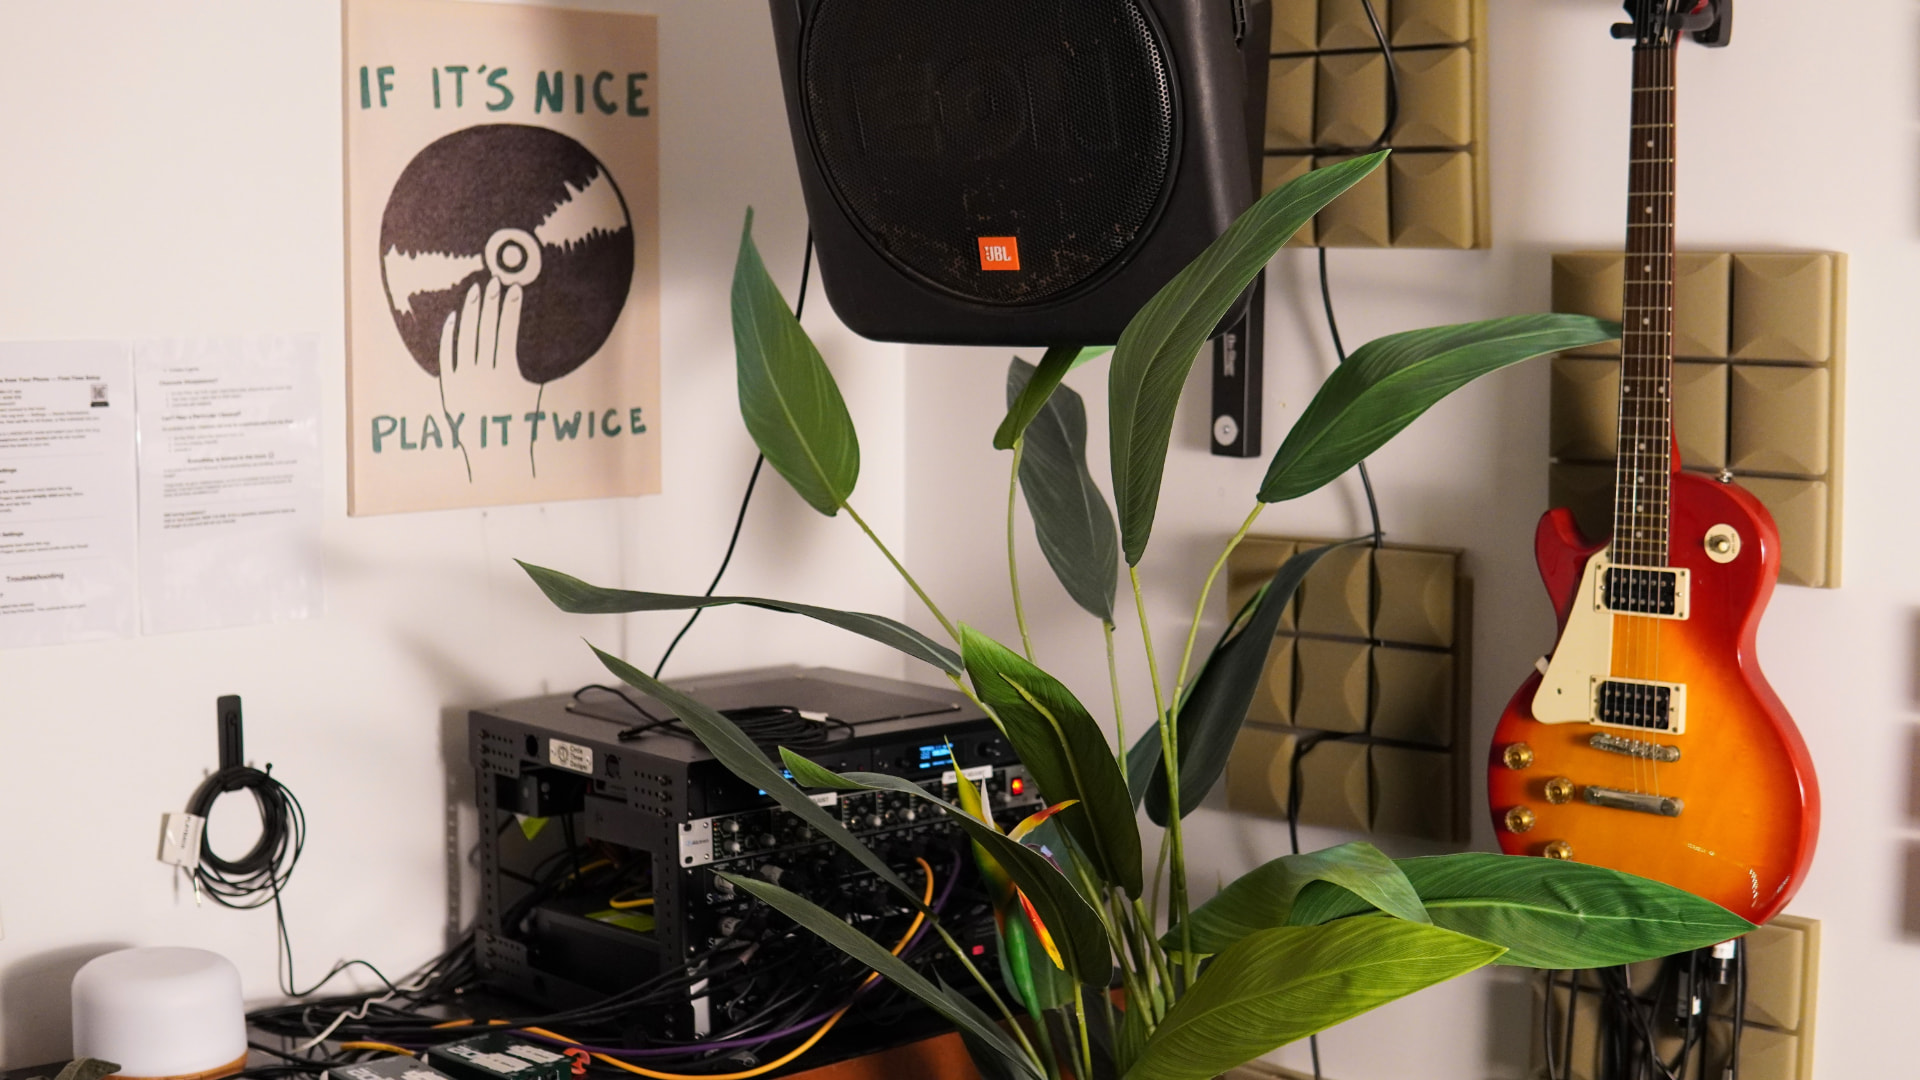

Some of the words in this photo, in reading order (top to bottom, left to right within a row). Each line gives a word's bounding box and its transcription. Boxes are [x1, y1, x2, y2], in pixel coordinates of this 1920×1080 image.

[360, 66, 395, 109] IF
[432, 64, 515, 112] IT'S
[533, 70, 650, 117] NICE
[984, 246, 1012, 262] JBL
[371, 412, 465, 454] PLAY
[480, 414, 513, 449] IT
[524, 407, 647, 443] TWICE
[6, 572, 64, 583] Troubleshooting
